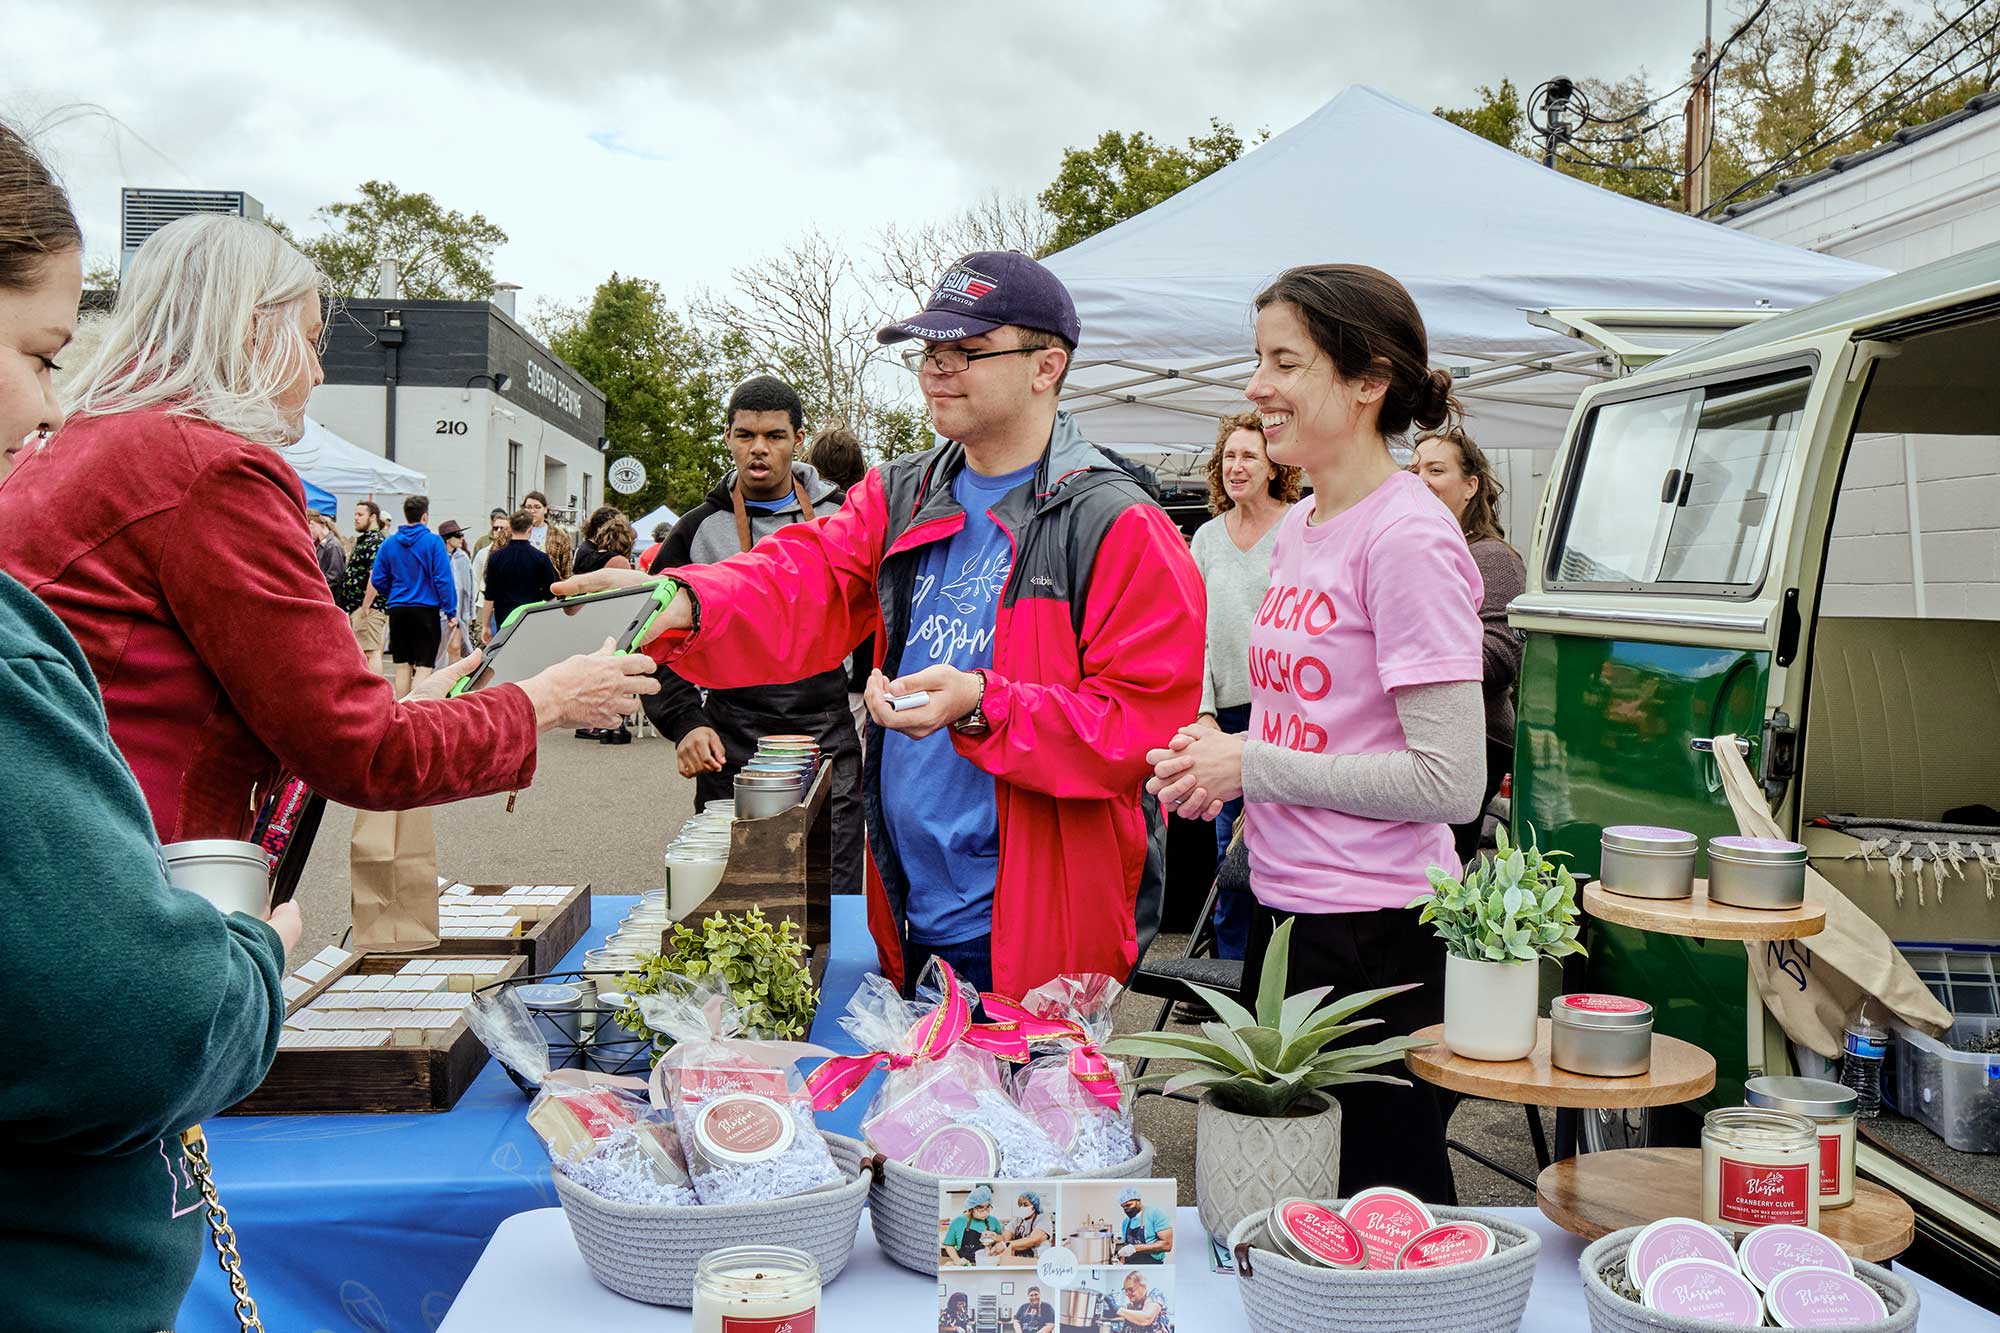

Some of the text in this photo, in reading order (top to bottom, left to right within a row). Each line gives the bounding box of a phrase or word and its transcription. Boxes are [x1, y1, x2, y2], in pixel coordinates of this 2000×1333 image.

[945, 271, 972, 292] GUN
[941, 293, 975, 307] AVIATION
[904, 323, 967, 339] FREEDOM
[435, 419, 468, 436] 210
[718, 1110, 756, 1134] Blossom
[1746, 1178, 1785, 1196] Blossom
[1735, 1196, 1774, 1208] CRANBERRY
[1294, 1217, 1329, 1241] CRANBERRY
[1329, 1239, 1349, 1253] CLOVE
[1303, 1211, 1345, 1243] Blossom
[1367, 1212, 1412, 1240] Blossom
[1414, 1253, 1450, 1266] CRANBERRY
[1452, 1248, 1473, 1257] CLOVE
[1420, 1239, 1467, 1258] Blossom
[1774, 1242, 1824, 1266] Blossom
[1041, 1261, 1074, 1277] Blossom
[1672, 1284, 1728, 1305] Blossom
[1795, 1288, 1851, 1306] Blossom
